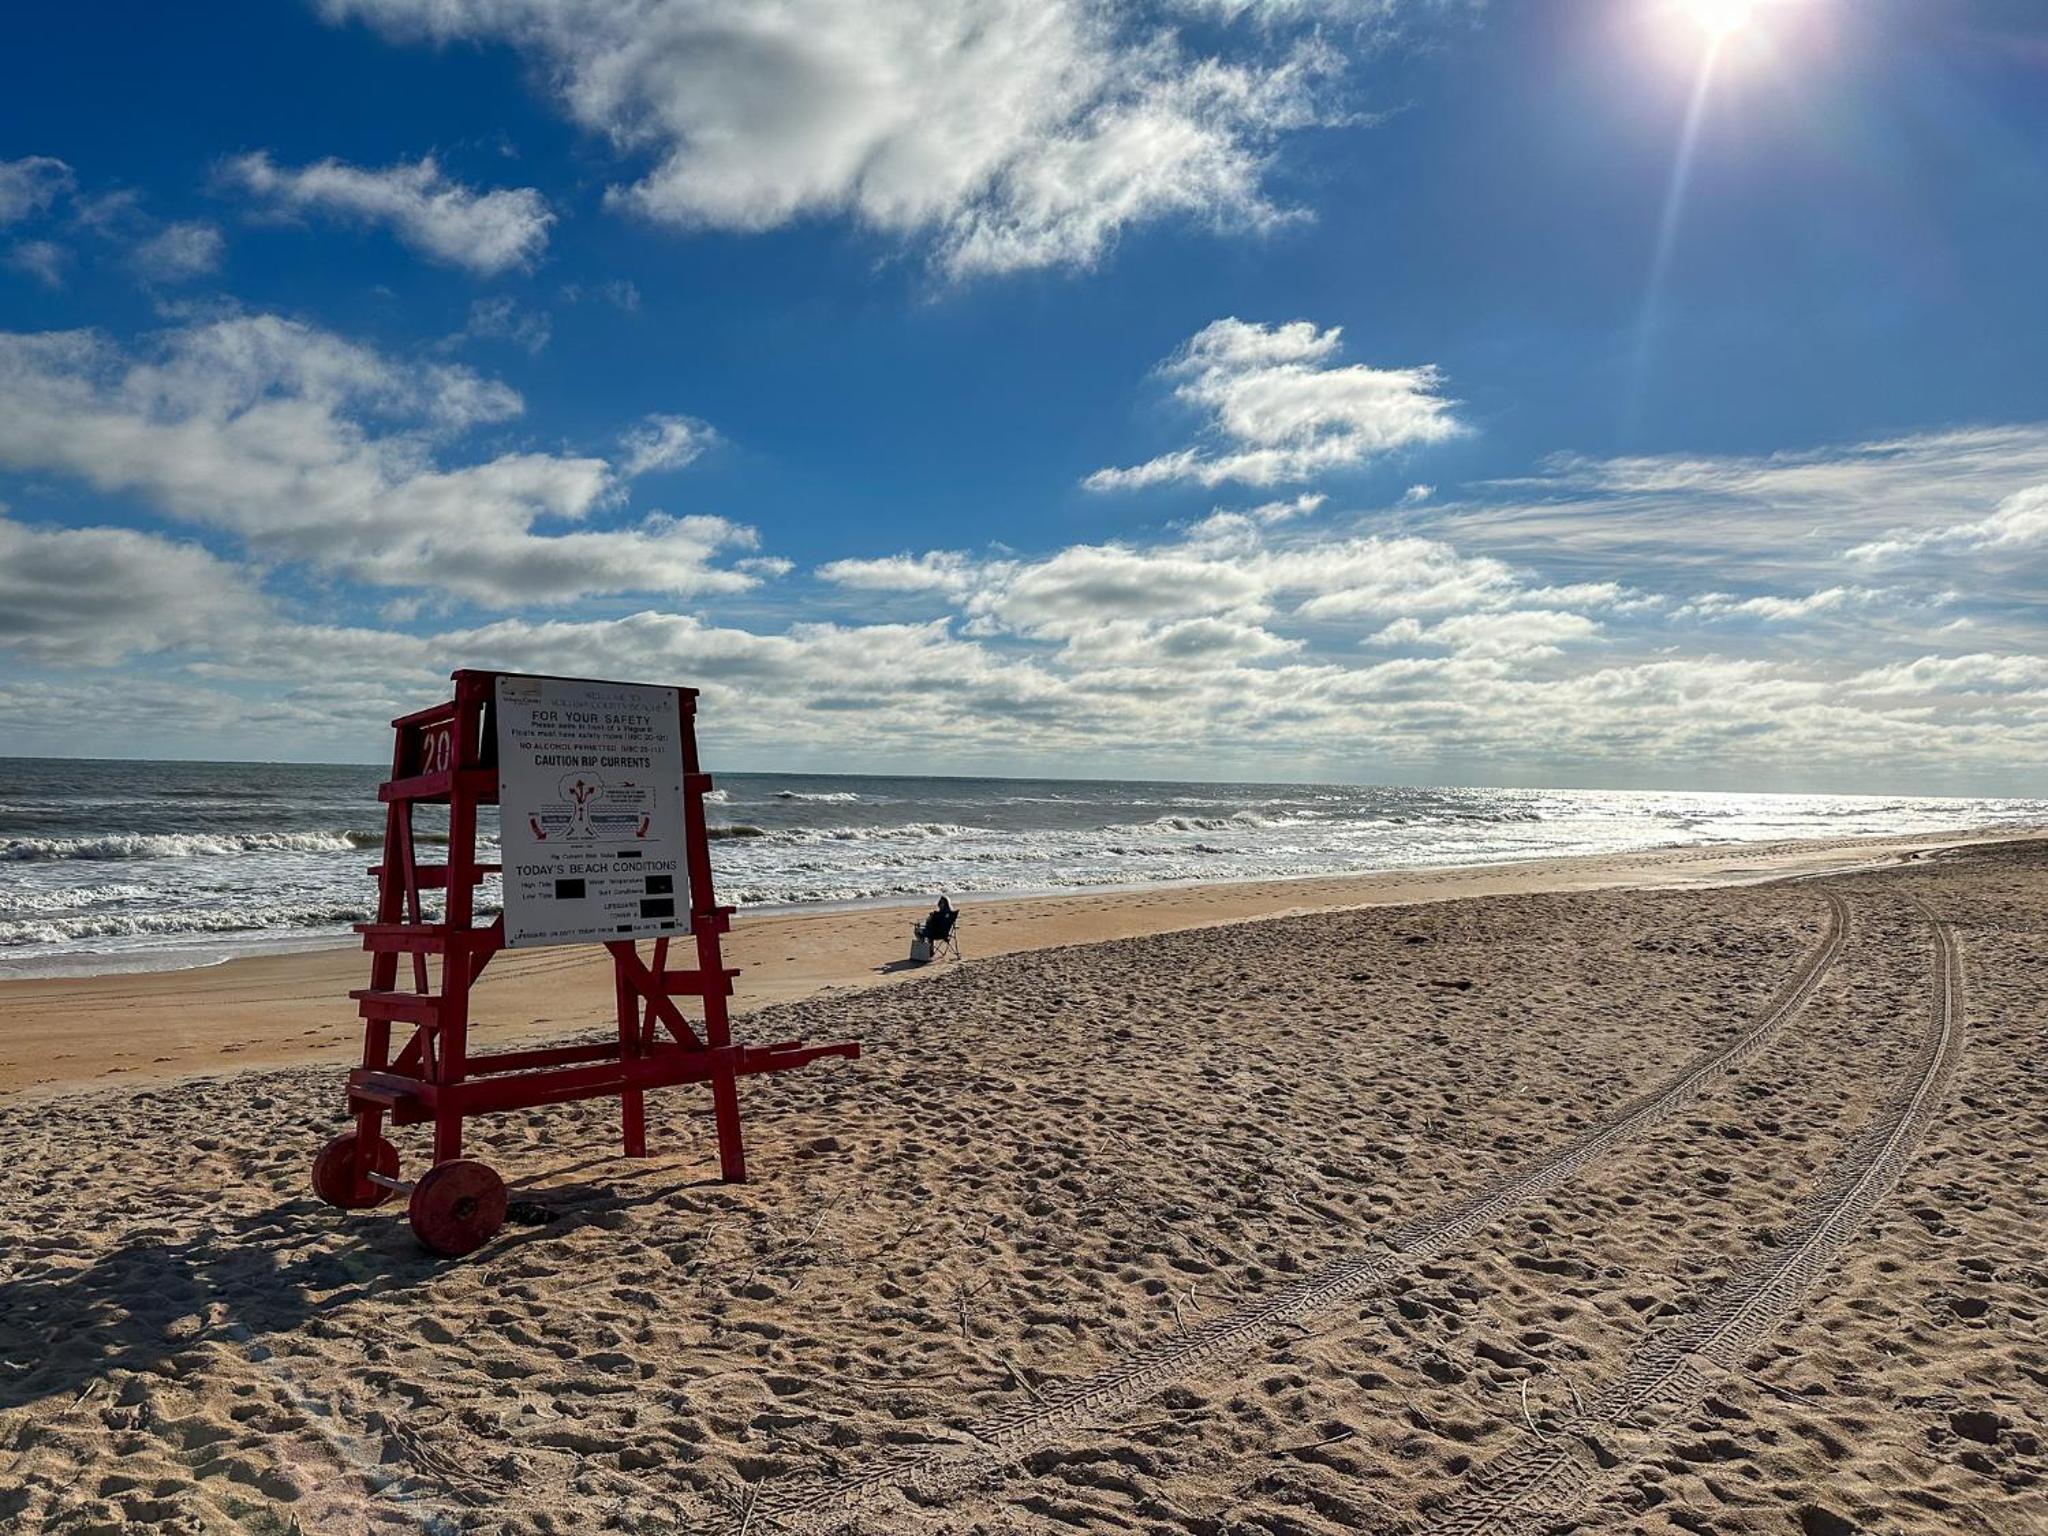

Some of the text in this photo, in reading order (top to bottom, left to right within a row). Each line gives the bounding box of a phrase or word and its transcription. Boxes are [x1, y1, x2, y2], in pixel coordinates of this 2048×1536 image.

[532, 710, 651, 725] FOR YOUR SAFETY
[422, 730, 450, 777] 20
[519, 742, 532, 750] NO
[534, 742, 572, 750] ALCOHOL
[534, 754, 651, 768] CAUTION RIP CURRENTS
[516, 860, 678, 876] TODAY'S BEACH CONDITIONS
